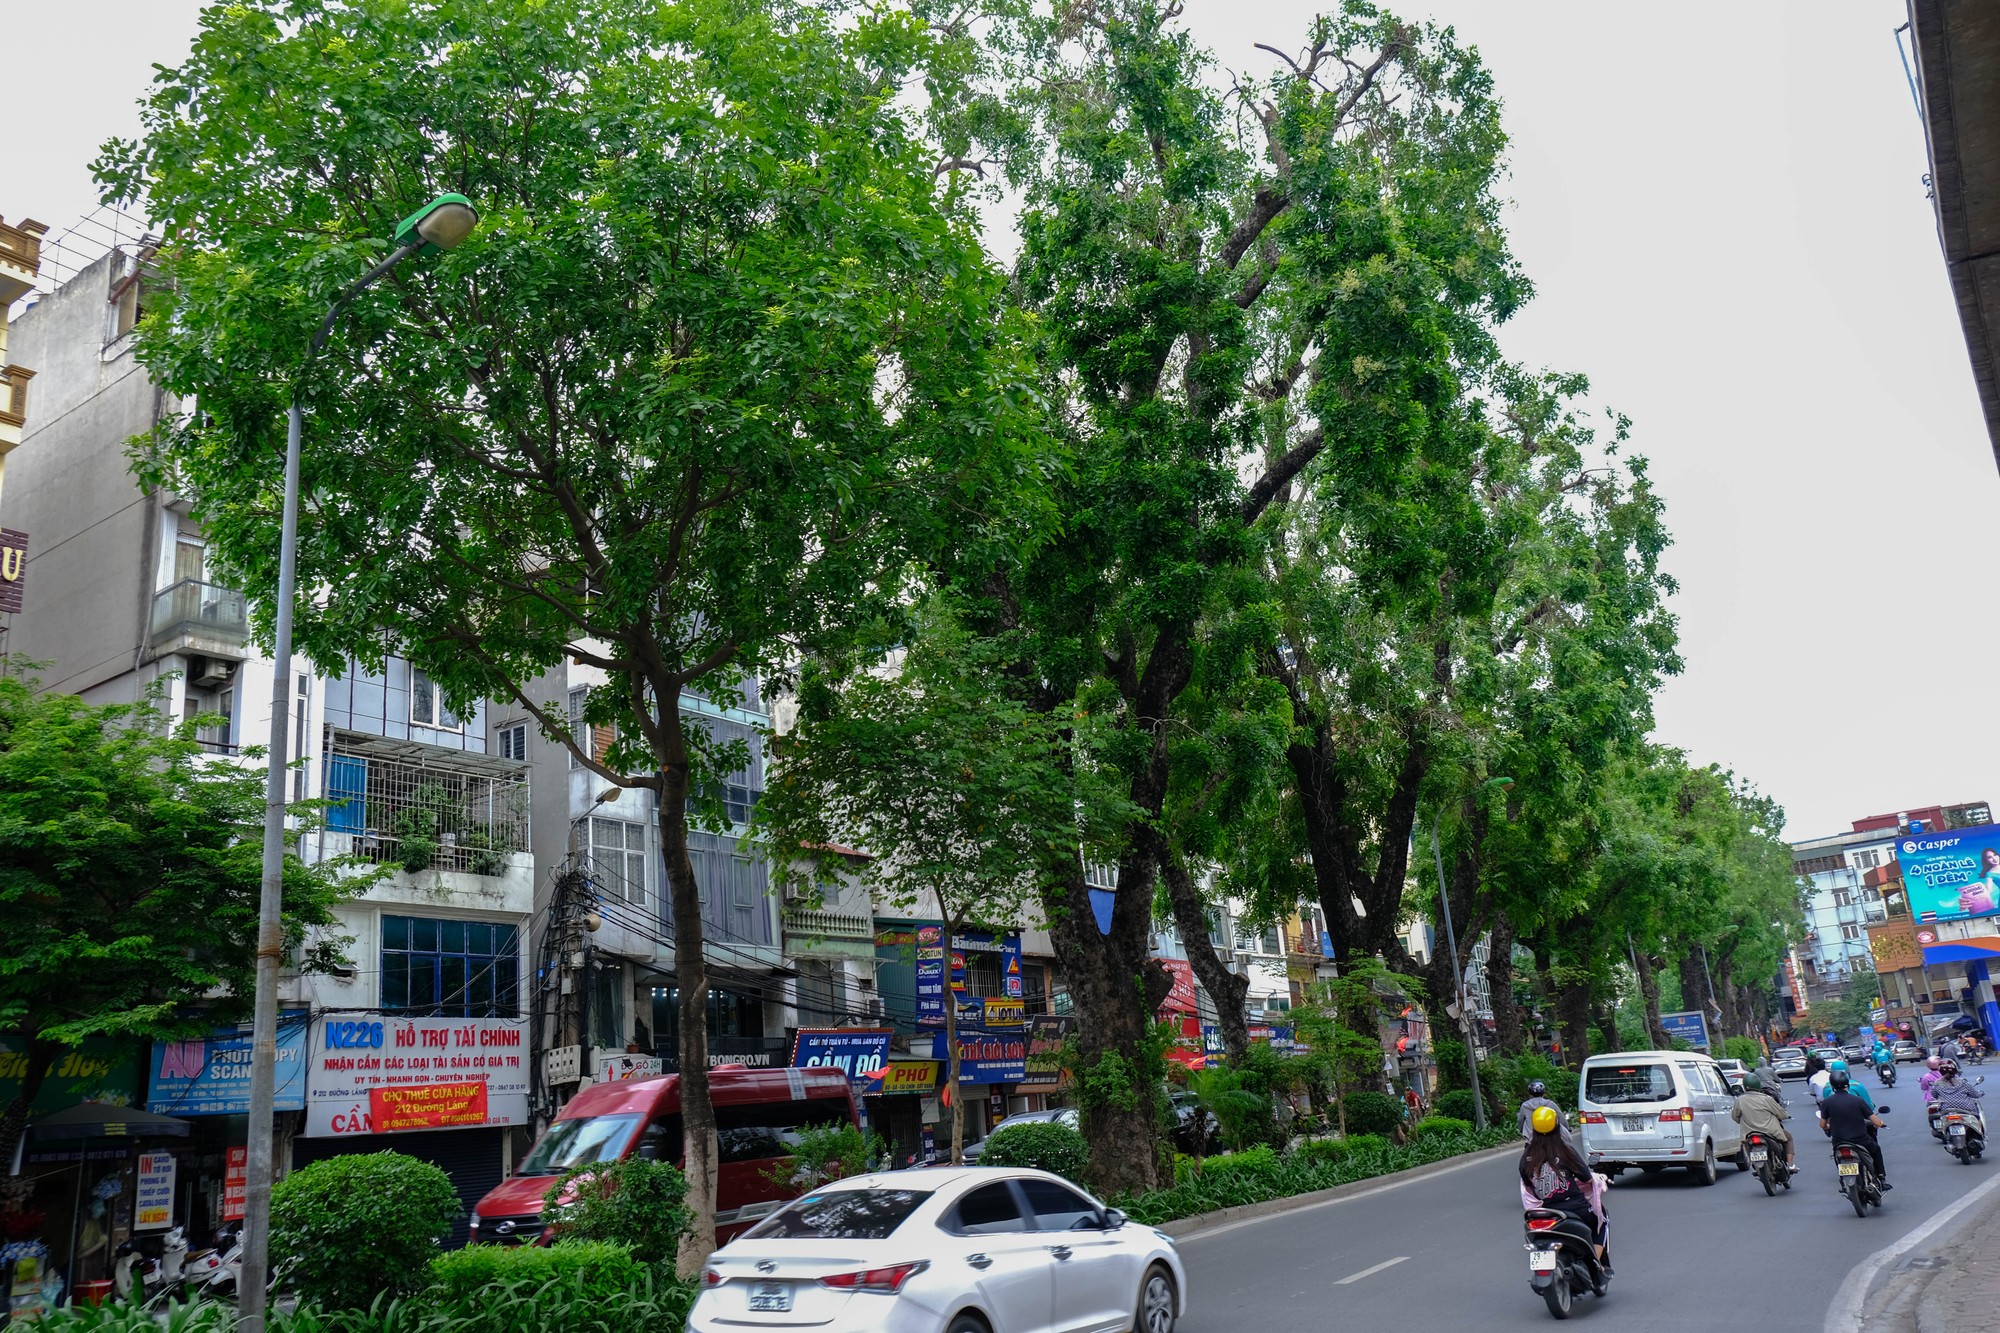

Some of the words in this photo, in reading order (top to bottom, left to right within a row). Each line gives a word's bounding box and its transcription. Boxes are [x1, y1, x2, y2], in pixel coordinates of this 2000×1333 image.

[1918, 838, 1960, 850] Casper
[1910, 865, 1921, 875] 4
[1925, 874, 1934, 886] 1
[997, 1007, 1024, 1021] JOTUN
[325, 1021, 384, 1049] N226
[421, 1027, 449, 1051] TRỢ
[480, 1026, 520, 1047] CHÍNH
[324, 1055, 355, 1073] NHẬN
[385, 1056, 405, 1069] CÁC
[407, 1057, 430, 1071] LOẠI
[433, 1055, 447, 1068] TÀI
[474, 1054, 486, 1068] CÓ
[488, 1054, 503, 1067] GIÁ
[506, 1056, 520, 1069] TRỊ
[707, 1053, 770, 1067] BONGRO.VN
[855, 1045, 882, 1078] ĐỒ
[211, 1065, 254, 1079] SCAN
[355, 1076, 365, 1084] UY
[368, 1075, 381, 1084] TÍN
[386, 1076, 413, 1084] NHANH
[415, 1075, 430, 1085] GỌN
[435, 1073, 463, 1082] CHUYÊN
[895, 1062, 930, 1083] PHỞ
[382, 1091, 403, 1103] CHO
[405, 1088, 430, 1101] THUÊ
[432, 1086, 453, 1099] CỬA
[455, 1085, 480, 1098] HÀNG
[395, 1103, 412, 1114] 212
[413, 1102, 445, 1113] Đường
[447, 1101, 469, 1111] Láng
[141, 1156, 153, 1174] IN
